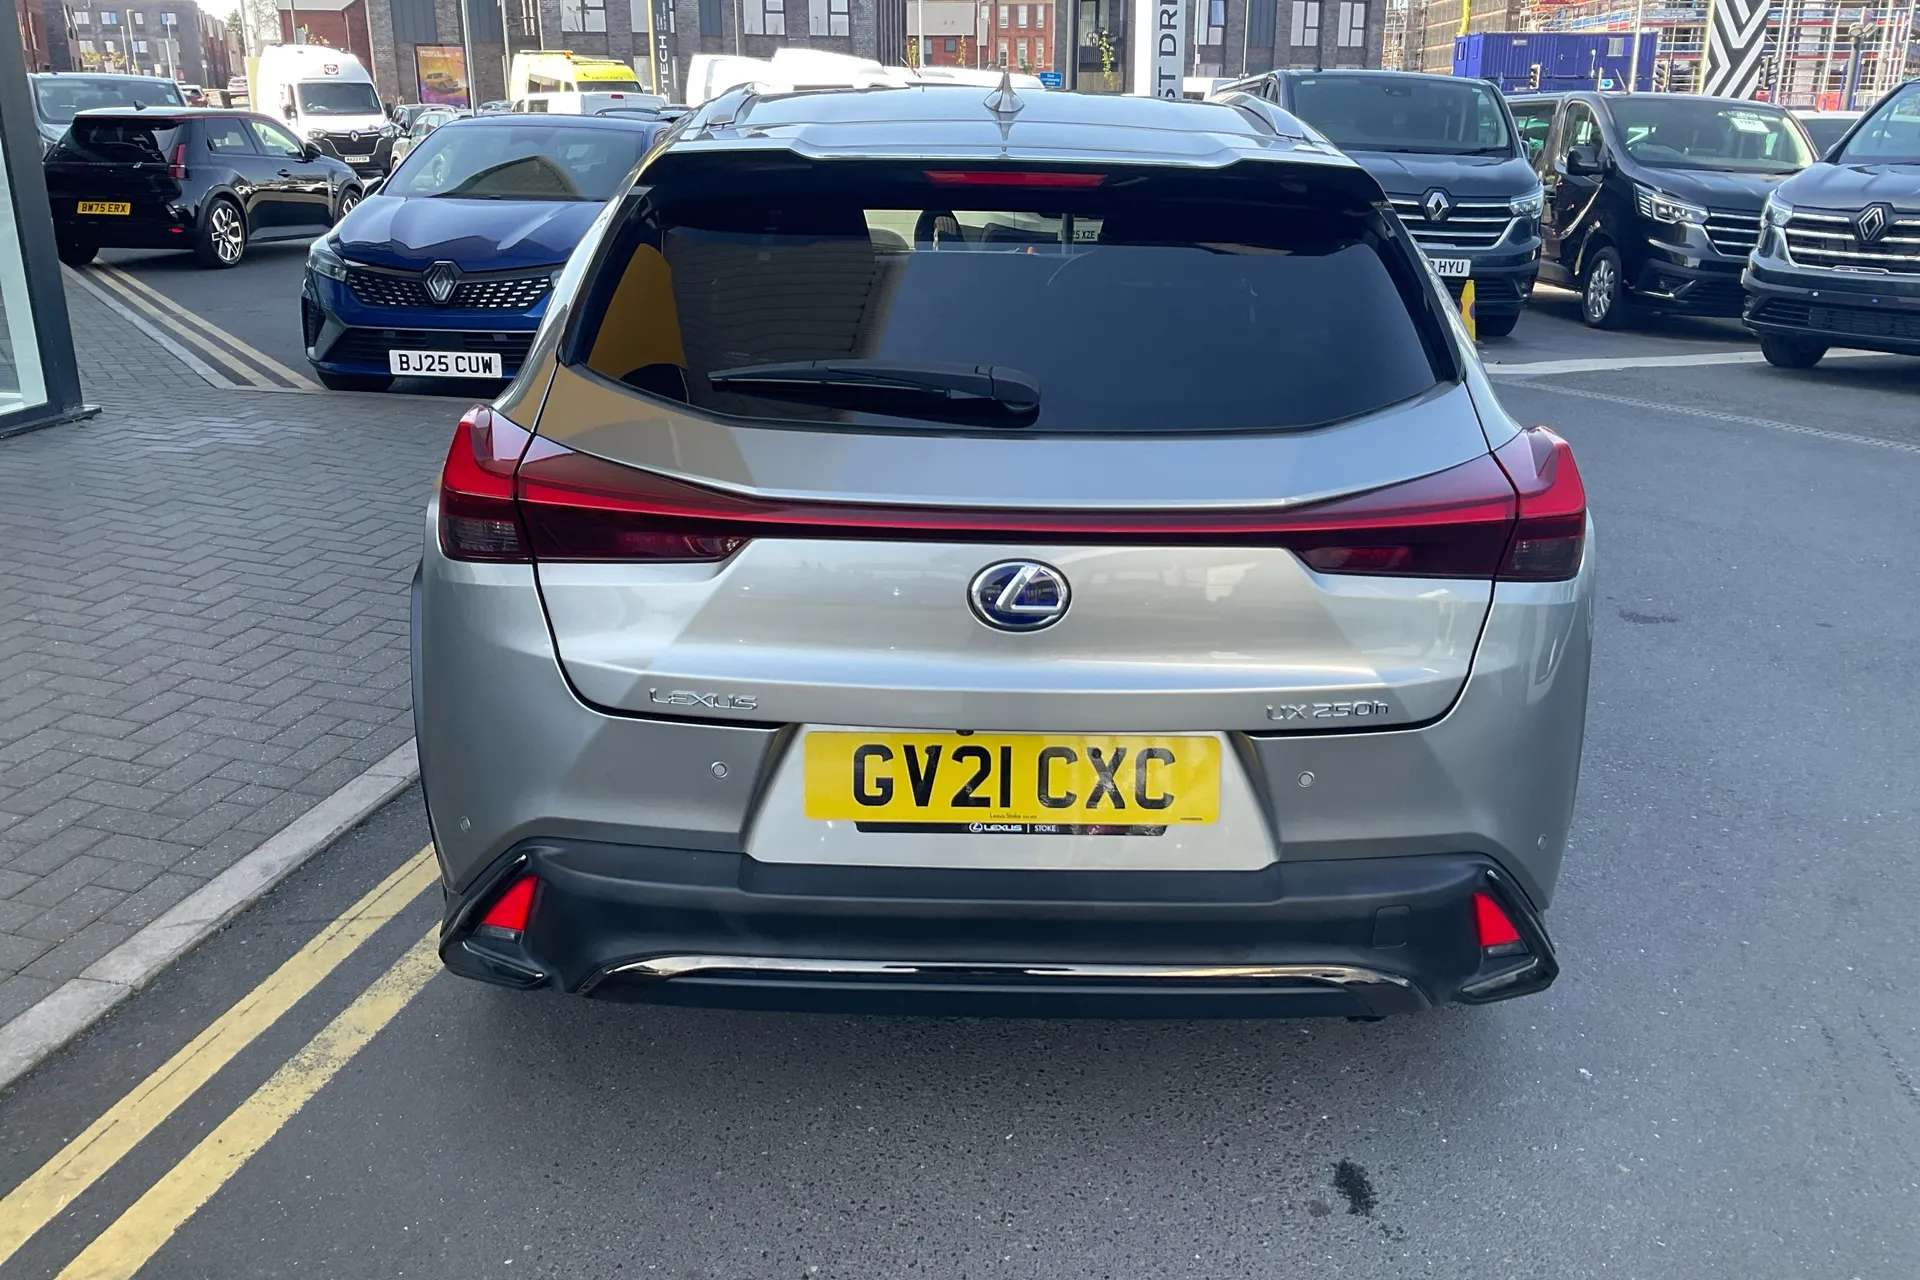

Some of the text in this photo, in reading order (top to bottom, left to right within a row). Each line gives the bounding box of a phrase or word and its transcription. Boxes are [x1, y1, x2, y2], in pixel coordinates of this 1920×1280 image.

[107, 203, 127, 213] ERX
[1438, 260, 1465, 274] HYU
[398, 353, 493, 374] BJ25 CUW
[648, 687, 759, 710] LEXUS
[1265, 699, 1389, 720] UX 250h
[853, 743, 1176, 810] GV21 CXC
[1034, 824, 1057, 833] STOKE
